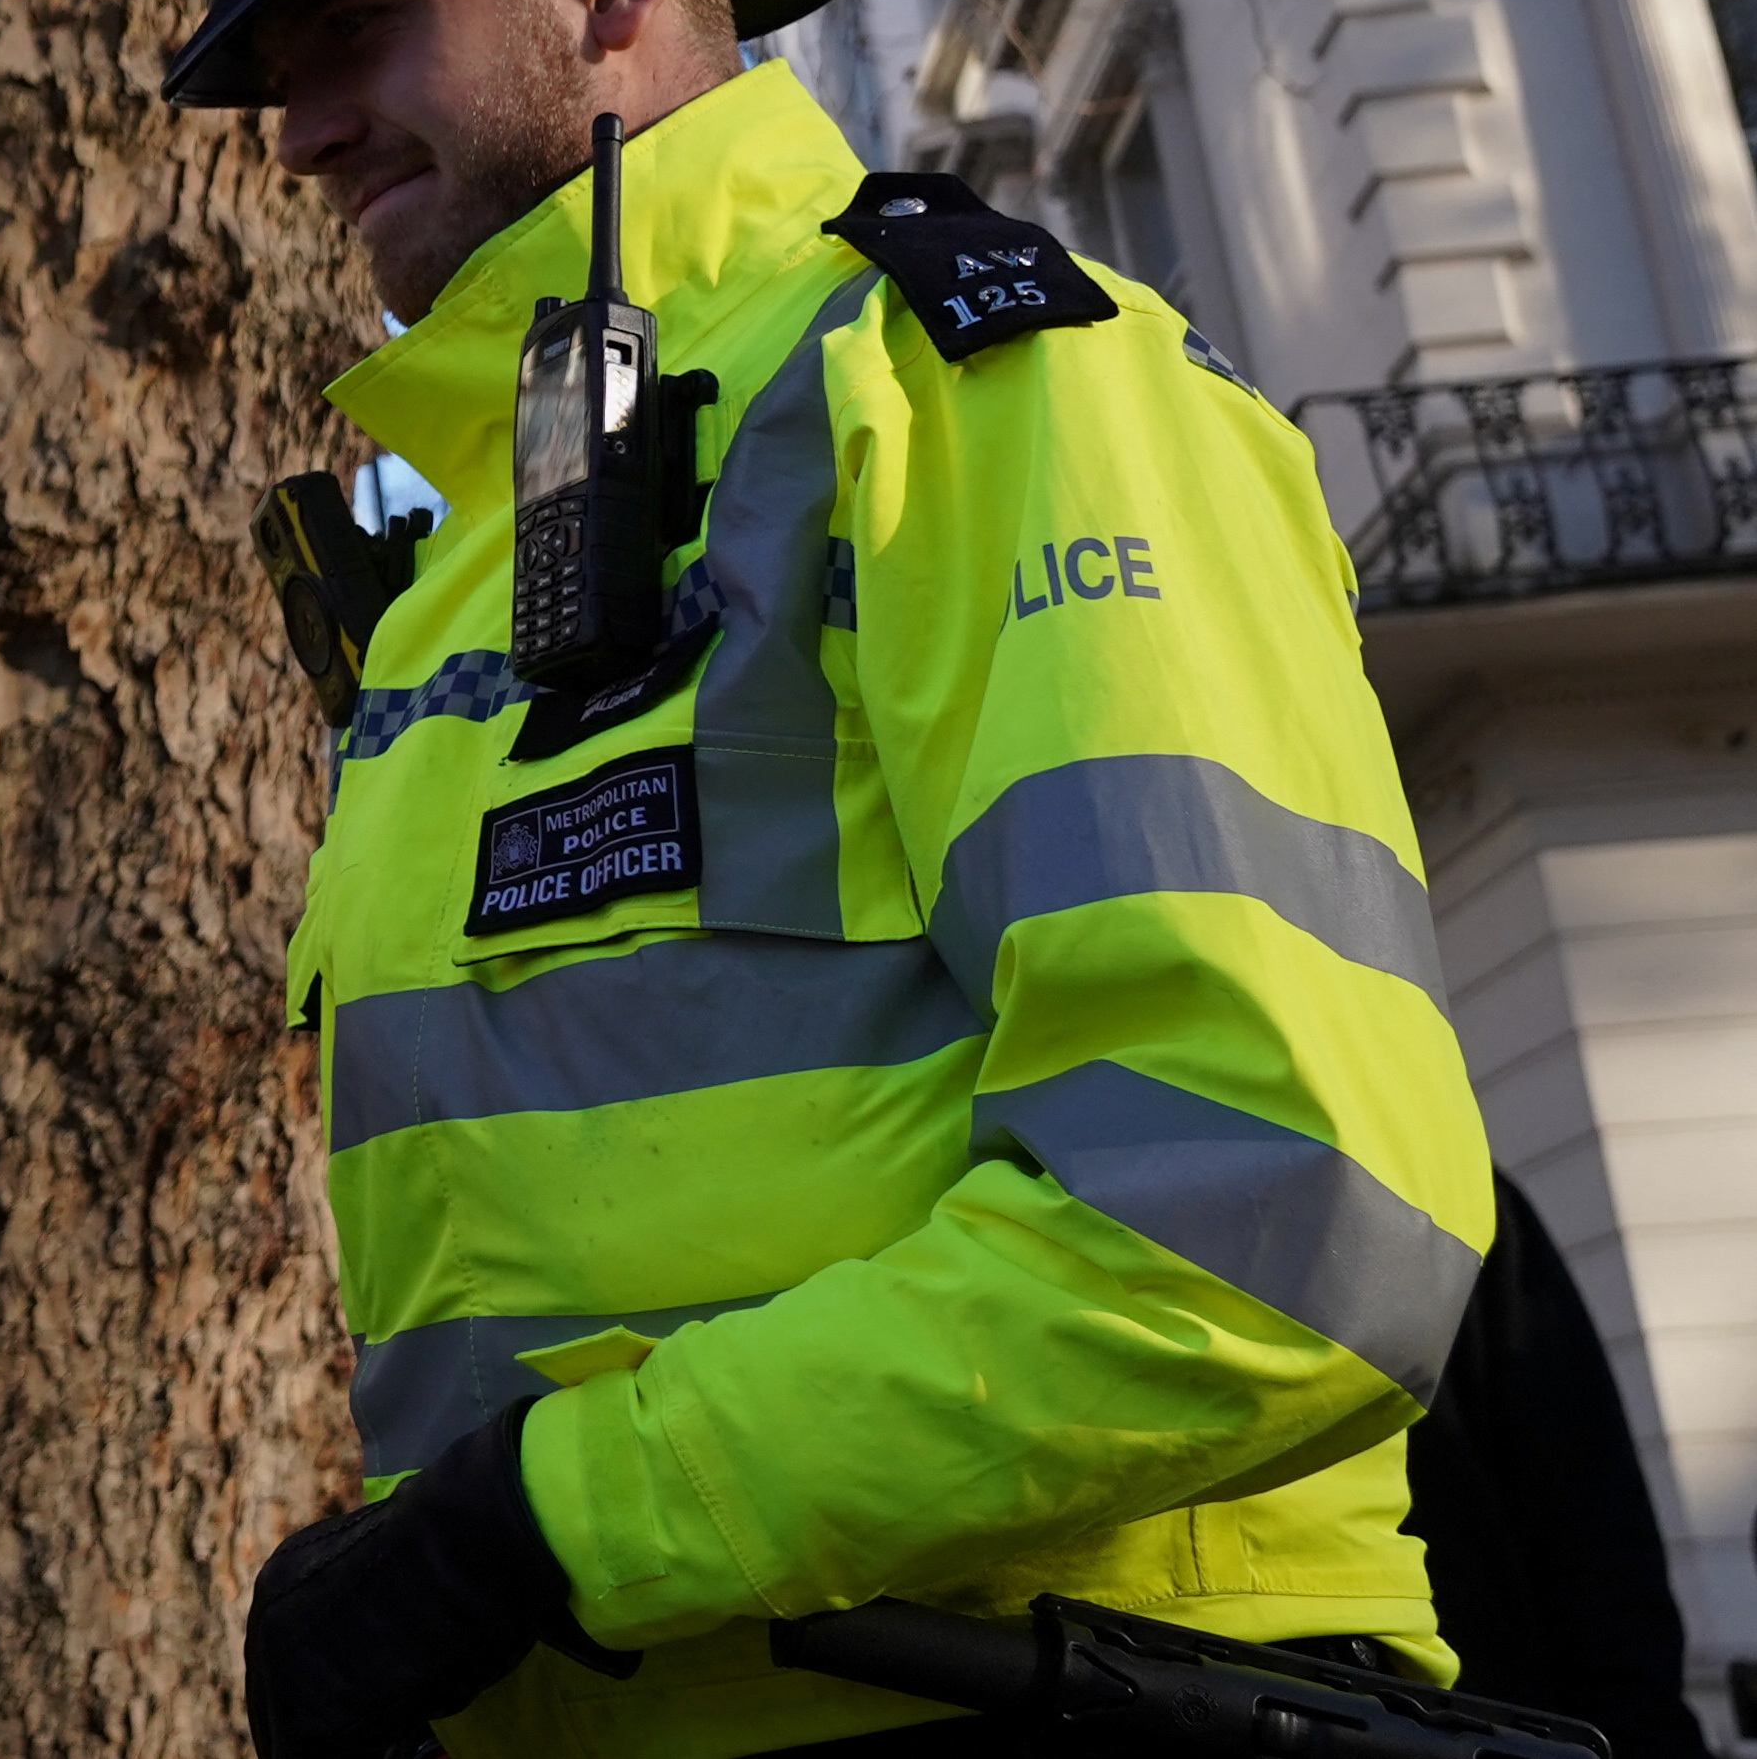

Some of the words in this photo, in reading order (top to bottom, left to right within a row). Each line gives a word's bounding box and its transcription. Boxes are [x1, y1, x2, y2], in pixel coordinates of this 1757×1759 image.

[955, 247, 1039, 279] AW
[943, 280, 1046, 330] 125
[545, 776, 667, 832] METROPOLITAN
[562, 806, 647, 855] POLICE
[481, 871, 572, 916] POLICE
[579, 841, 682, 895] OFFICER
